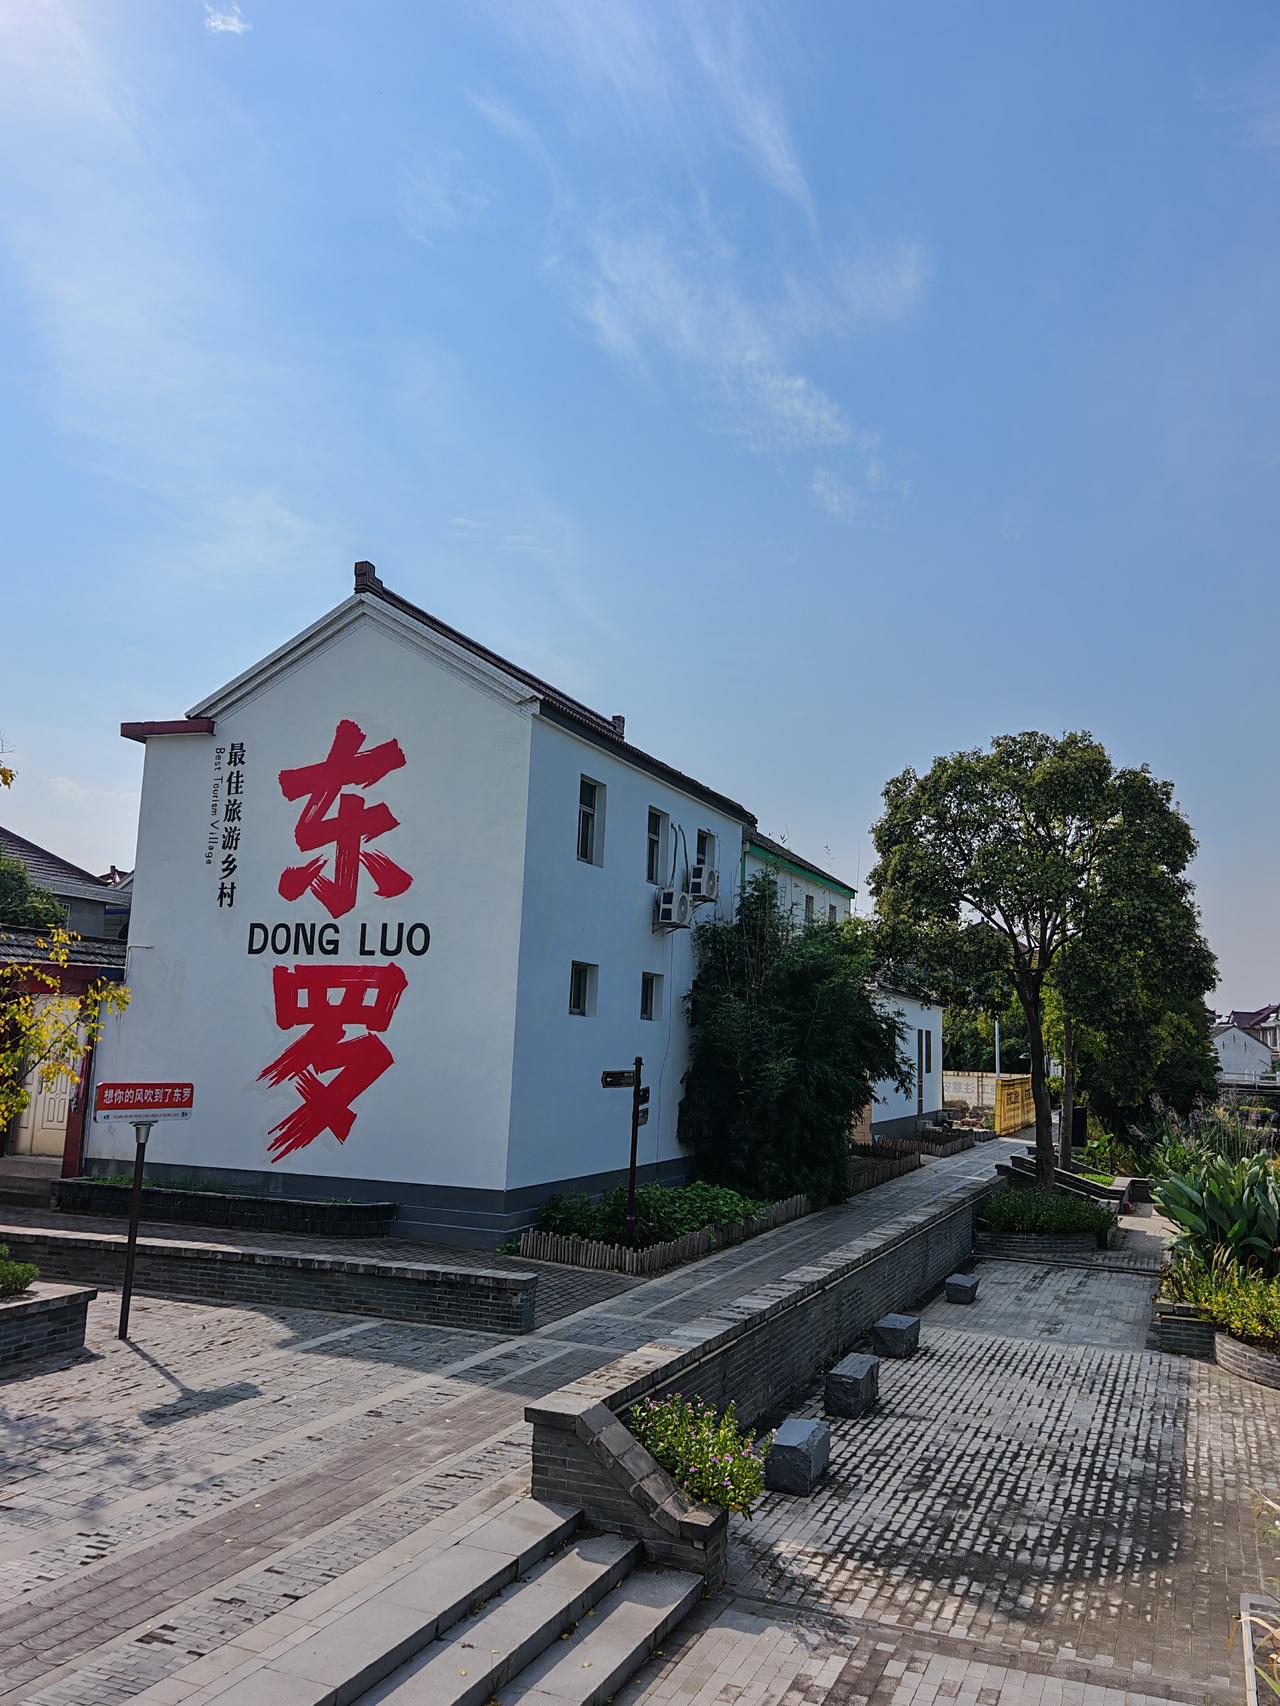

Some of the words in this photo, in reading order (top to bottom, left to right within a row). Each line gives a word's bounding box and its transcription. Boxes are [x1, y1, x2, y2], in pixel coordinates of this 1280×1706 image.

[215, 747, 226, 771] Best
[211, 775, 224, 816] Tourism
[205, 819, 220, 865] Village
[216, 742, 246, 908] 最佳旅游乡村
[248, 923, 340, 955] DONG
[359, 923, 430, 956] LUO
[103, 1088, 192, 1104] 想你的风吹到了东罗
